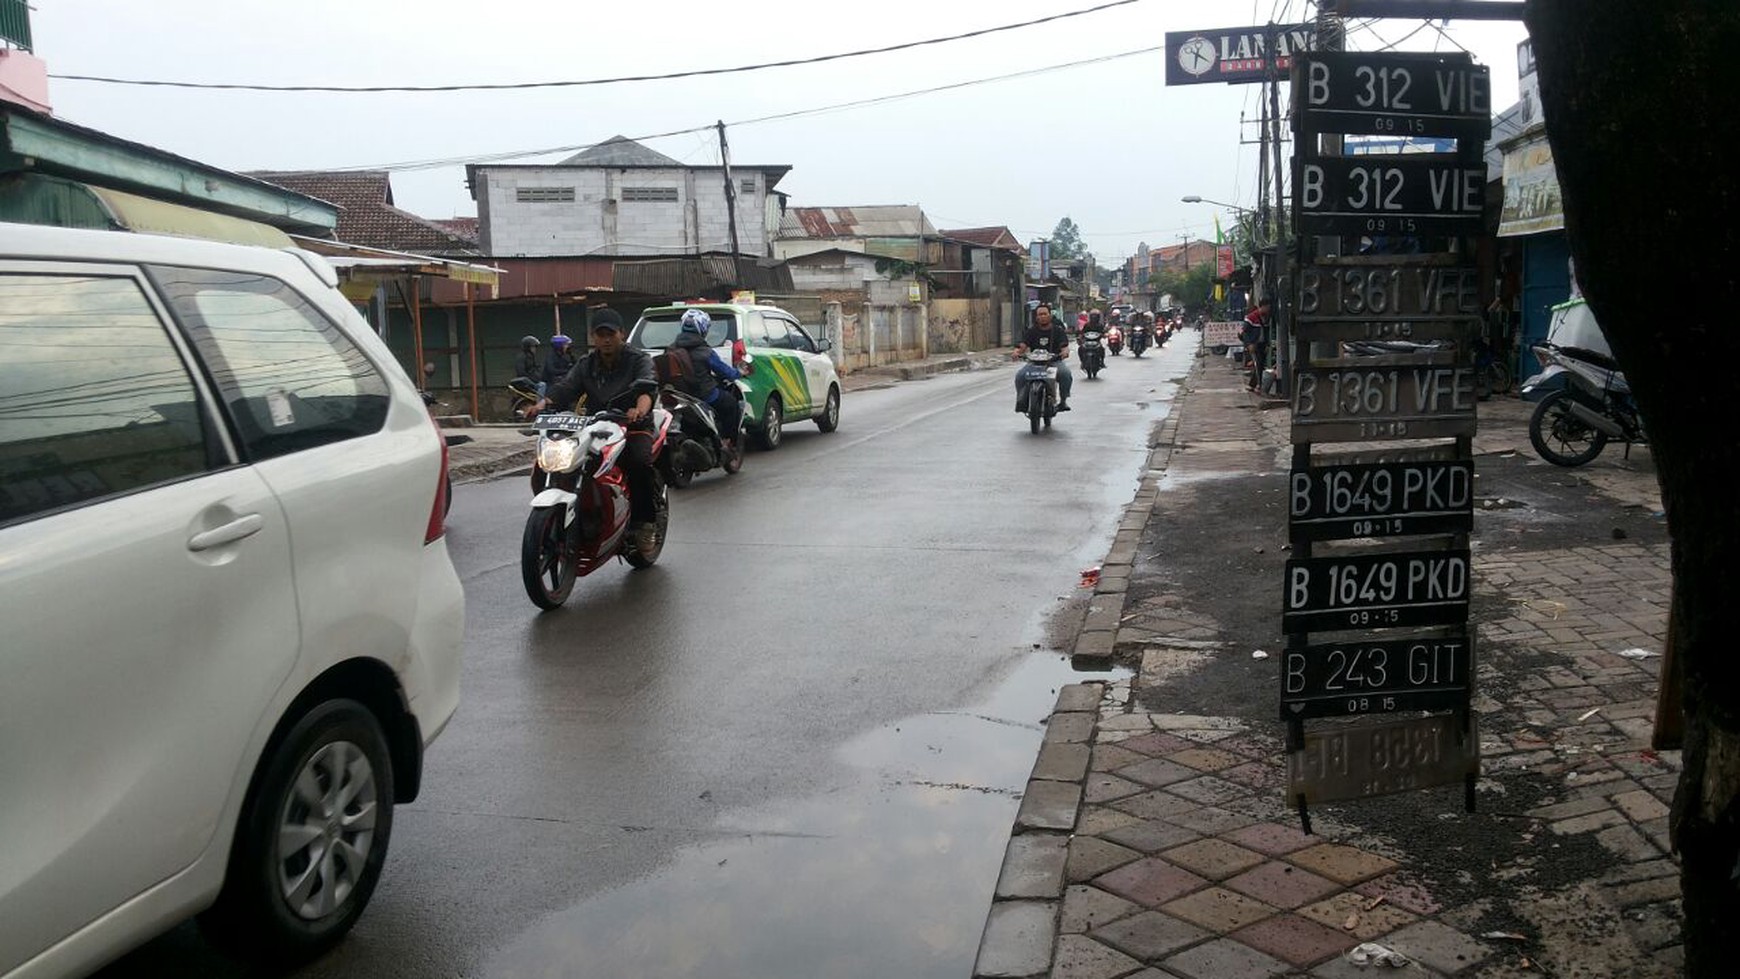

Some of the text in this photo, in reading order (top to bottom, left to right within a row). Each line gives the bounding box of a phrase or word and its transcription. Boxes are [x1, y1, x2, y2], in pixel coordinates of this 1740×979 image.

[1308, 61, 1490, 113] B 312 VIE
[1375, 117, 1424, 132] 09 15
[1302, 164, 1324, 208] B
[1347, 166, 1404, 210] 312
[1428, 168, 1483, 211] VIE
[1366, 218, 1416, 232] 09 15
[1299, 267, 1478, 314] B 1361 VFE
[1295, 367, 1474, 416] B 1361 VFE
[1291, 466, 1469, 516] B 1649 PKD
[1290, 556, 1465, 609] B 1649 PKD
[1286, 644, 1462, 693] B 243 GIT
[1382, 696, 1396, 710] 15
